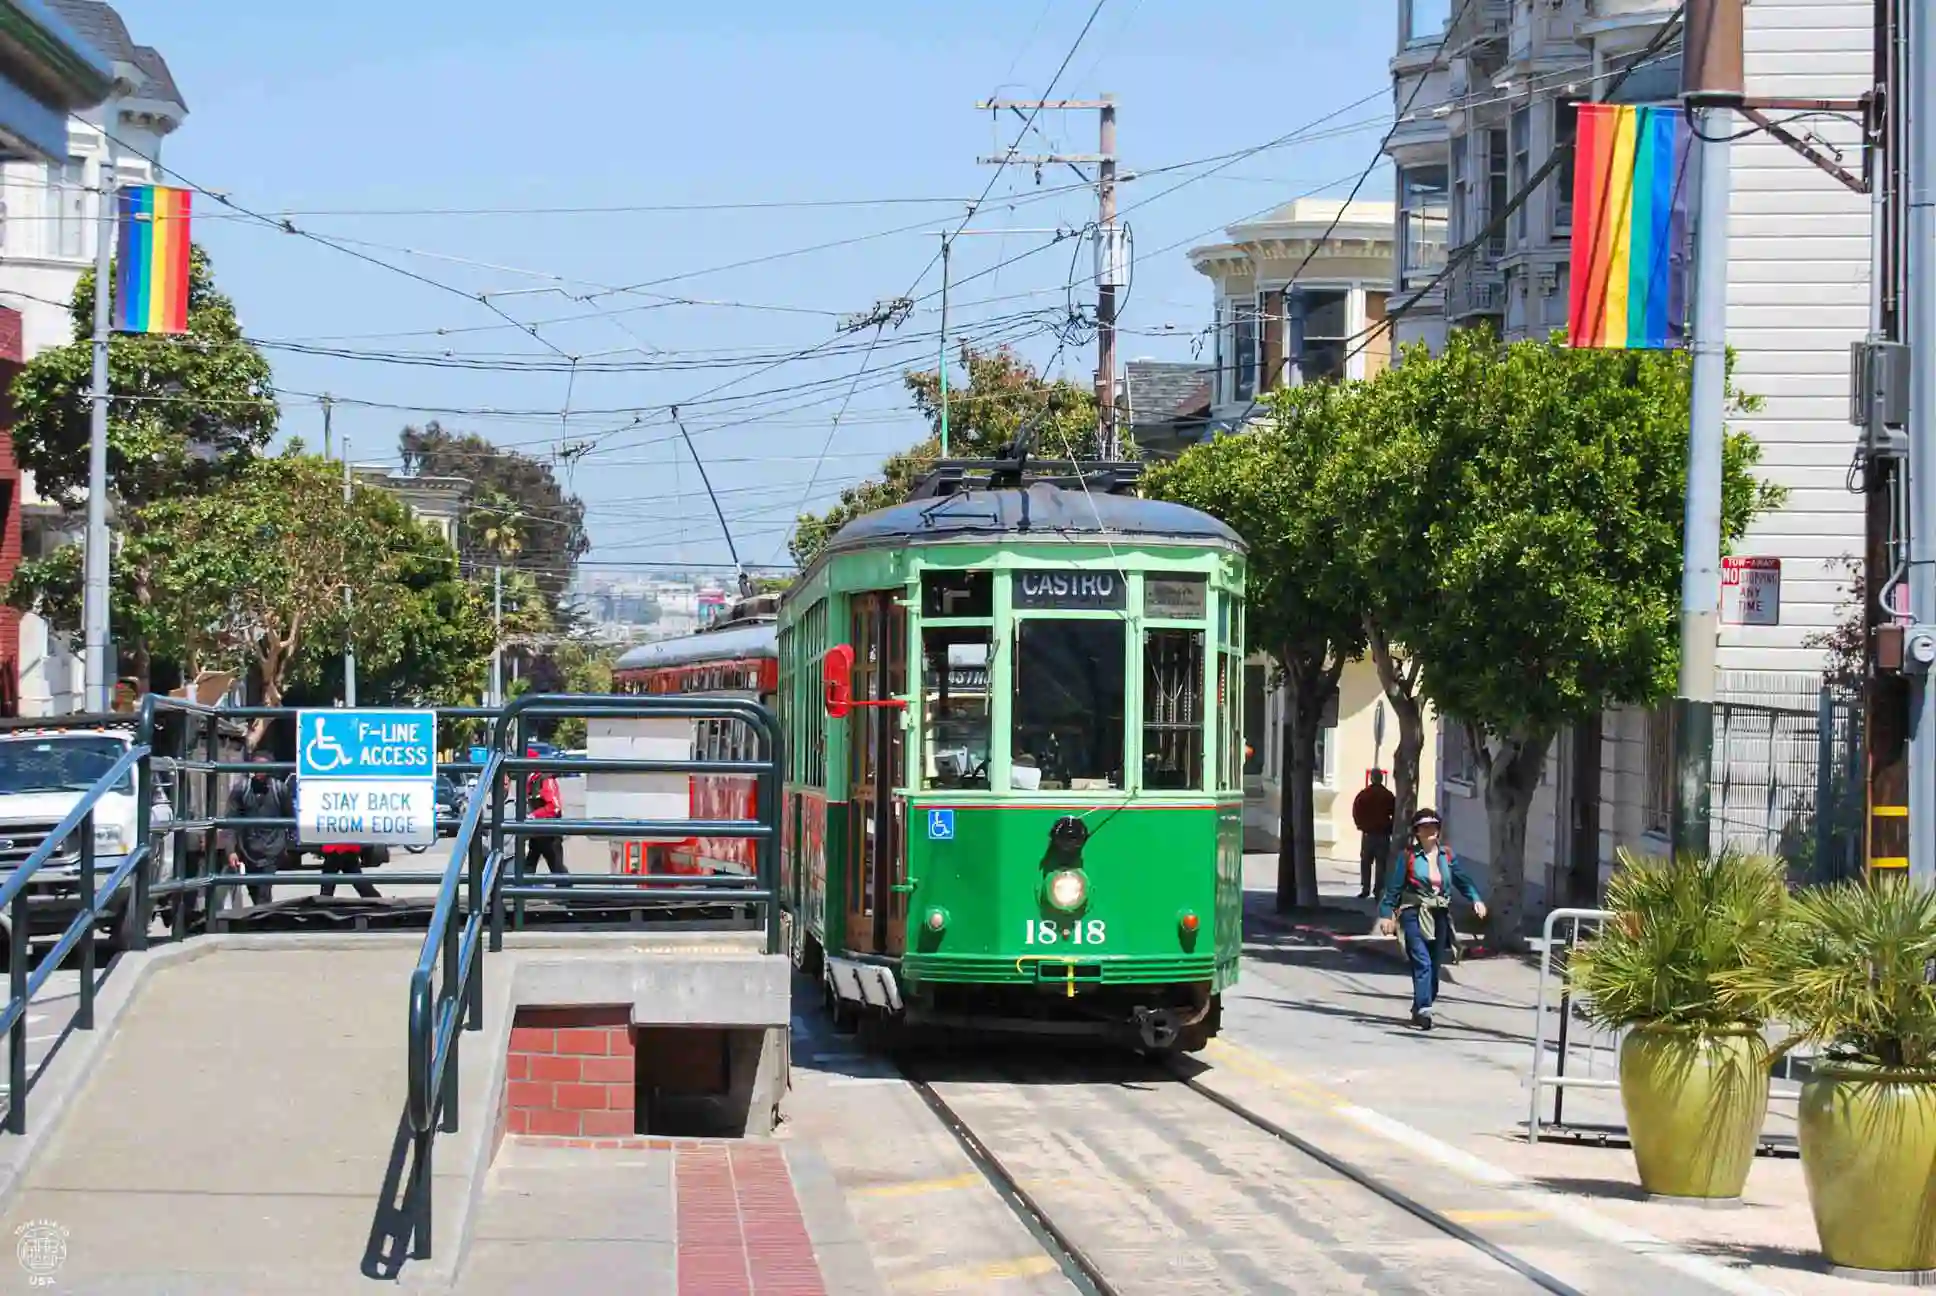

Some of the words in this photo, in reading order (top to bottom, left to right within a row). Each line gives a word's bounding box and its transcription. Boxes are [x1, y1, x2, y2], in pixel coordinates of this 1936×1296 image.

[1022, 573, 1114, 596] CASTRO
[1723, 568, 1739, 584] NO
[1740, 586, 1760, 598] ANY
[1739, 600, 1764, 612] TIME
[359, 722, 420, 742] F-LINE
[360, 746, 428, 766] ACCESS
[321, 792, 359, 811] STAY
[368, 792, 411, 811] BACK
[316, 815, 363, 833] FROM
[372, 815, 418, 833] EDGE
